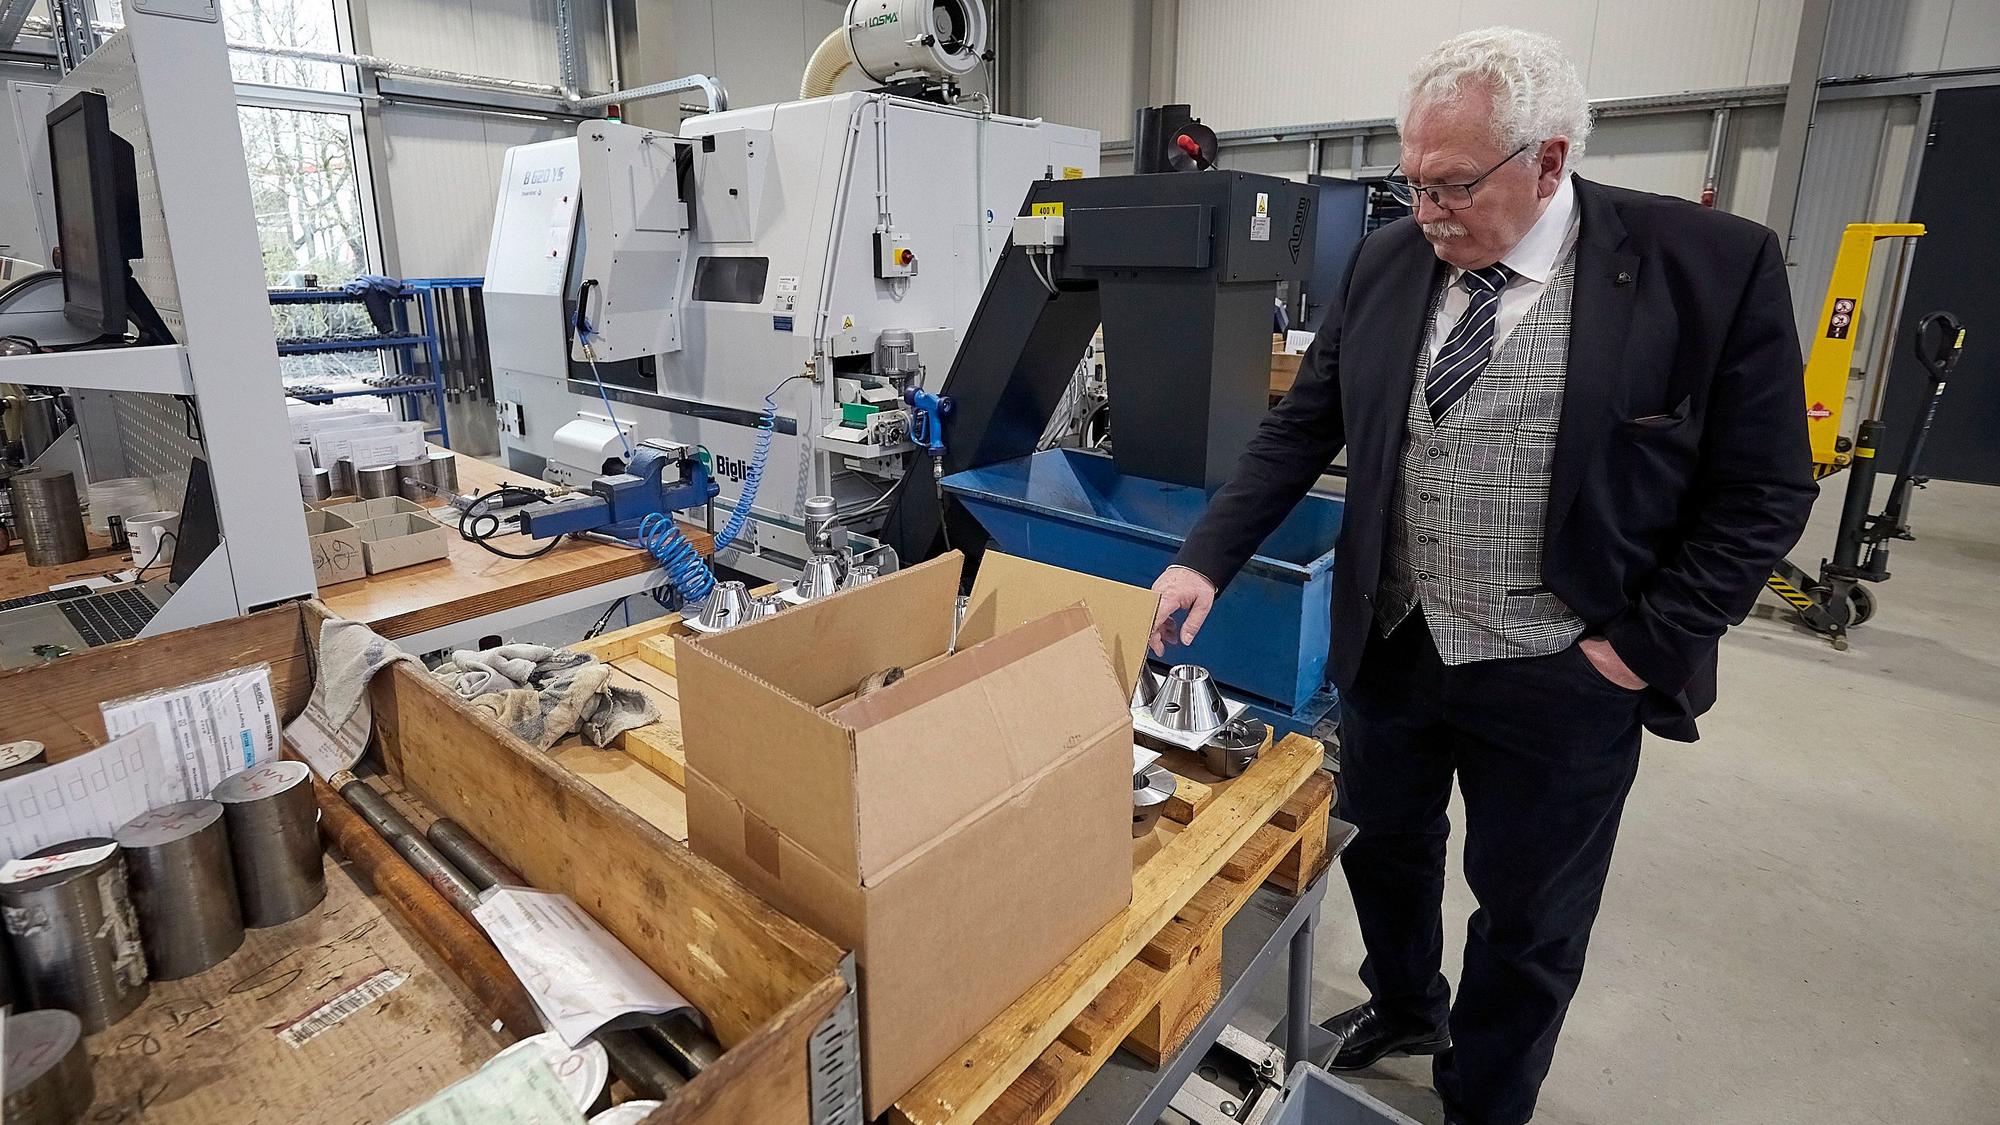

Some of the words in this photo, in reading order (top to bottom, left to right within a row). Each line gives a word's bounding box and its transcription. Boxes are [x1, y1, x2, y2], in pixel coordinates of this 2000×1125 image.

[869, 12, 898, 28] LOSMA
[1039, 206, 1050, 215] 400
[1051, 206, 1056, 215] V
